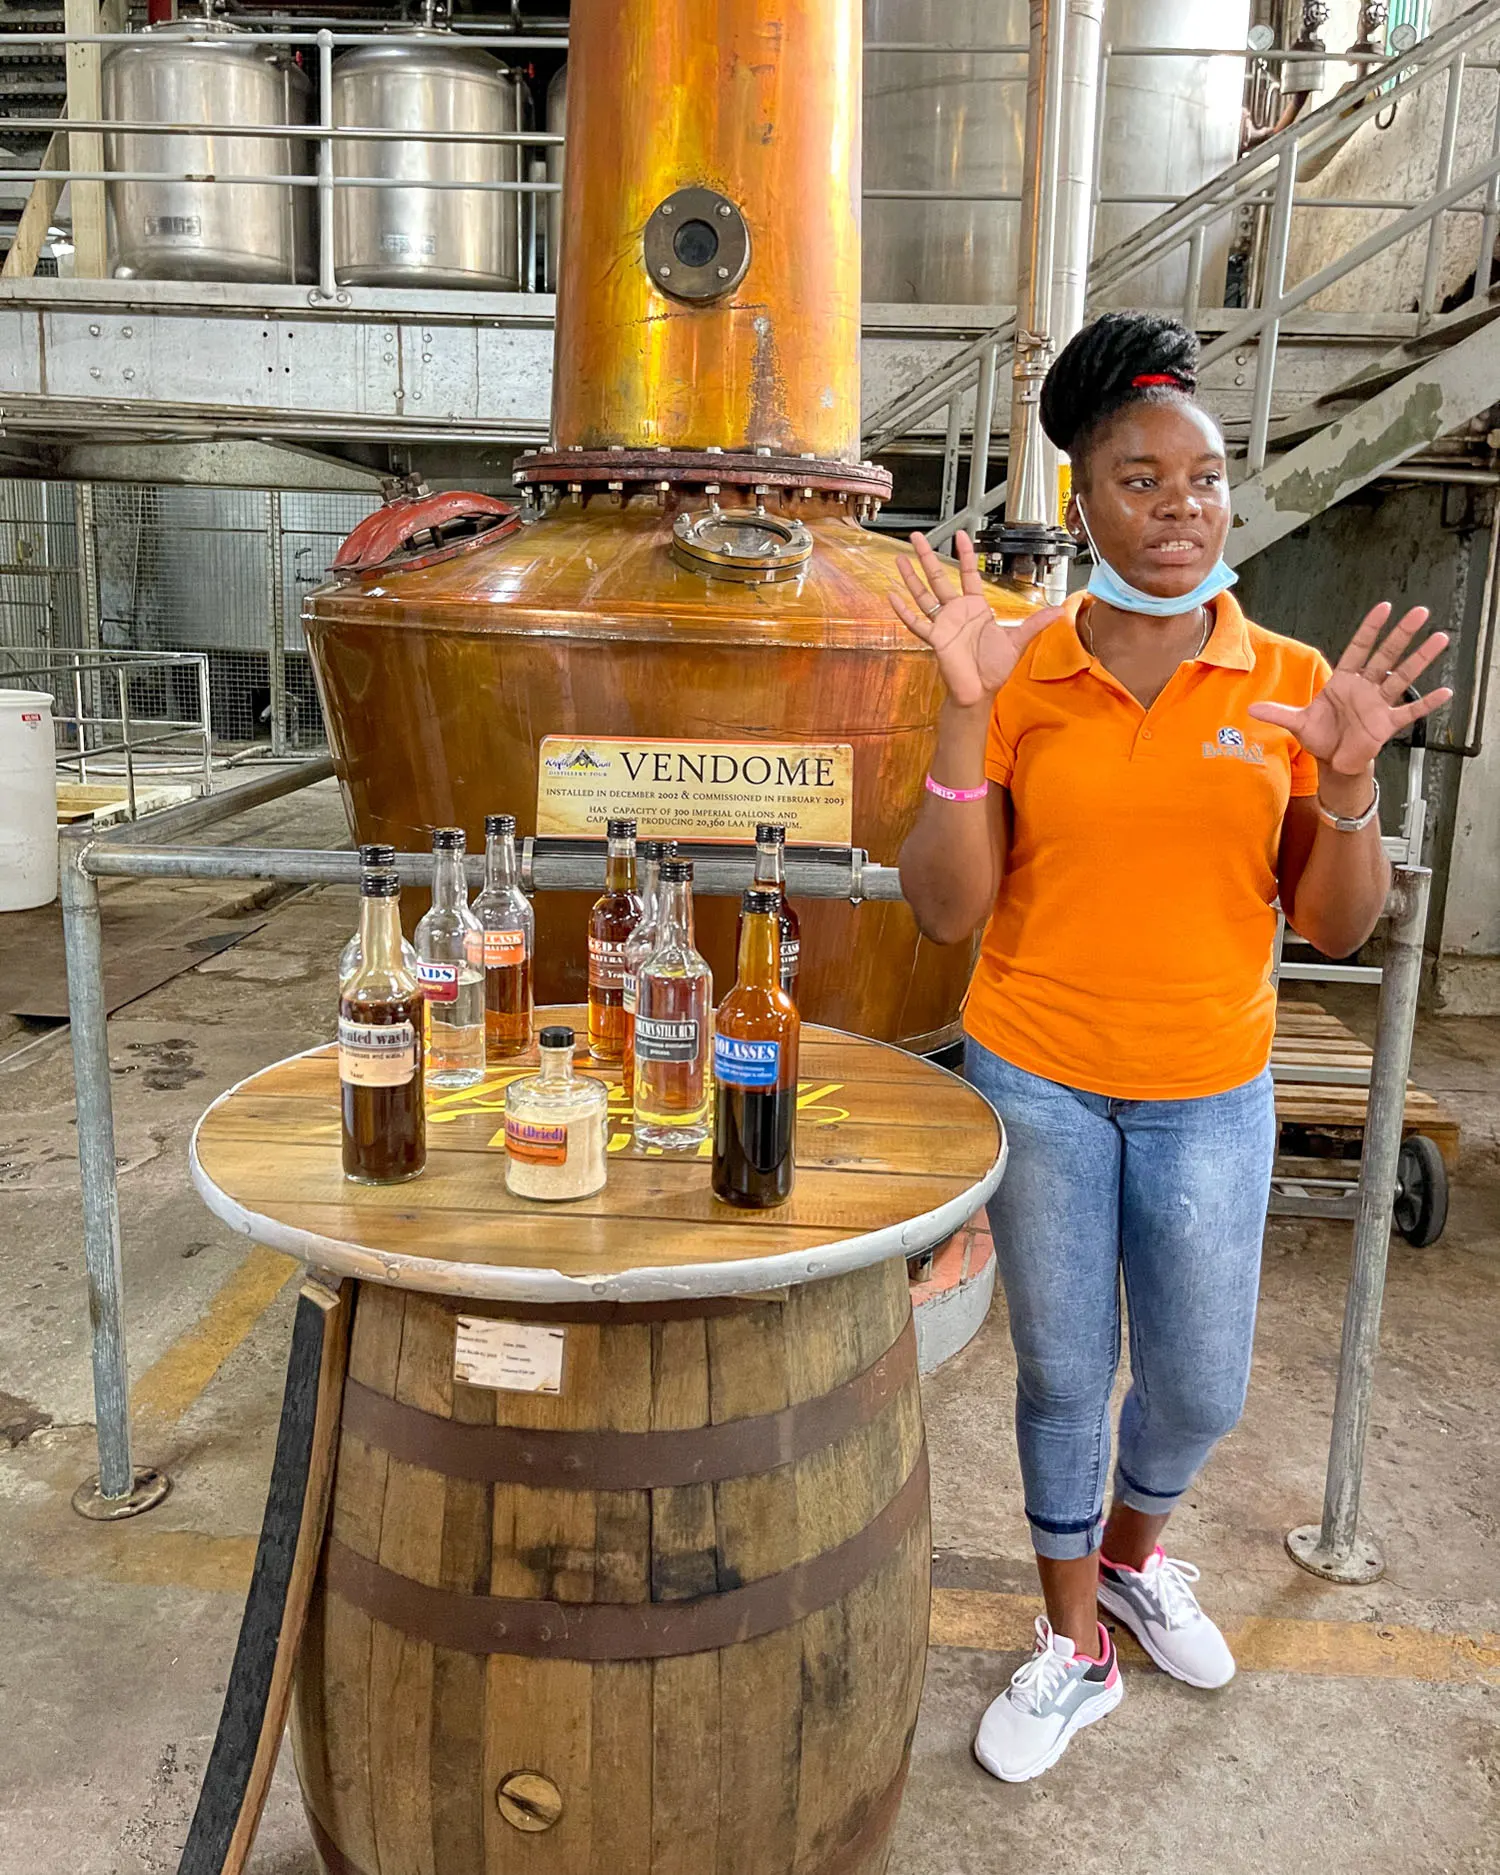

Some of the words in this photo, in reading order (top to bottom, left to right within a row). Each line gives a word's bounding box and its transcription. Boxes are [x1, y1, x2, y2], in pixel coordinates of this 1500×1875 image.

[619, 752, 835, 786] VENDOME
[546, 788, 594, 797] INSTALLED
[596, 789, 607, 797] IN
[609, 790, 655, 798] DECEMBER
[658, 791, 678, 799] 2002
[681, 790, 690, 800] &
[692, 792, 762, 802] COMMISSIONED
[764, 794, 775, 802] IN
[776, 795, 822, 804] FEBRUARY
[824, 797, 845, 806] 2003
[589, 806, 608, 814] HAS
[612, 806, 658, 815] CAPACITY
[659, 807, 671, 815] OF
[674, 808, 690, 817] 300
[692, 809, 733, 818] IMPERIAL
[734, 810, 775, 819] GALLONS
[777, 811, 798, 820] AND
[641, 817, 694, 826] PRODUCING
[696, 819, 725, 828] 20,360
[727, 820, 745, 828] LAA
[376, 1028, 410, 1045] wash
[655, 1024, 677, 1038] STILL
[679, 1024, 696, 1038] RUM
[523, 1124, 563, 1142] (Dried)
